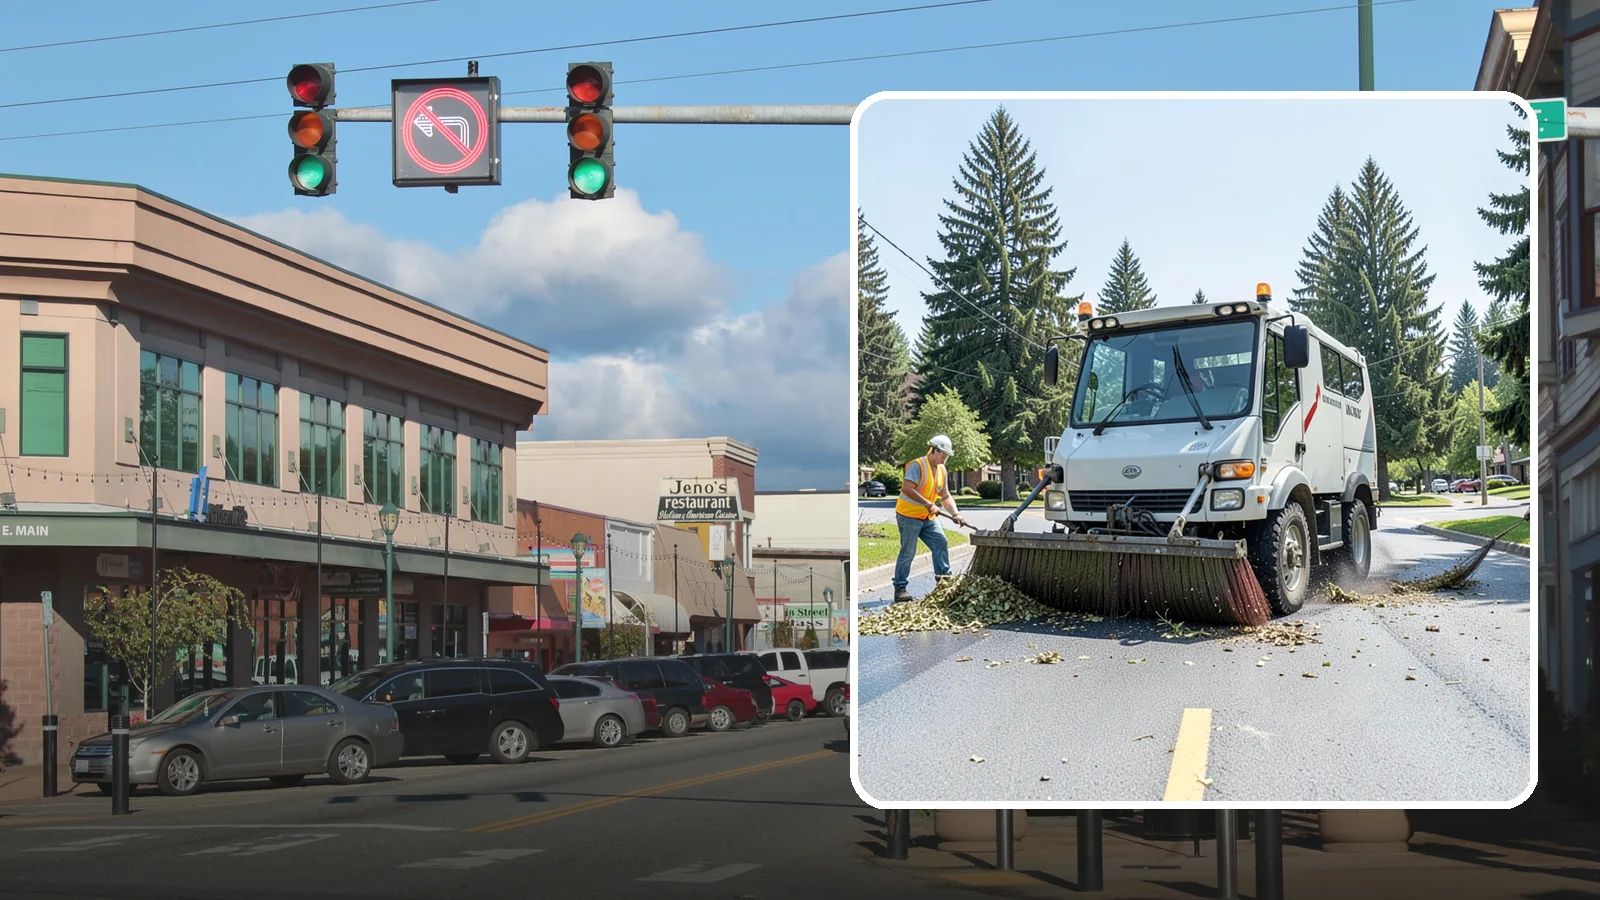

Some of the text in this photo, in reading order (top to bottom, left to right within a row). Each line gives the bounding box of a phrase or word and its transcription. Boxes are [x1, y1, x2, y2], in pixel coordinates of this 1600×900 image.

[670, 480, 727, 495] Jeno's
[665, 496, 731, 509] restaurant
[658, 509, 681, 519] Italian
[686, 509, 714, 519] American
[715, 509, 737, 519] Cuisine
[2, 525, 49, 536] E. MAIN
[797, 607, 829, 617] Street
